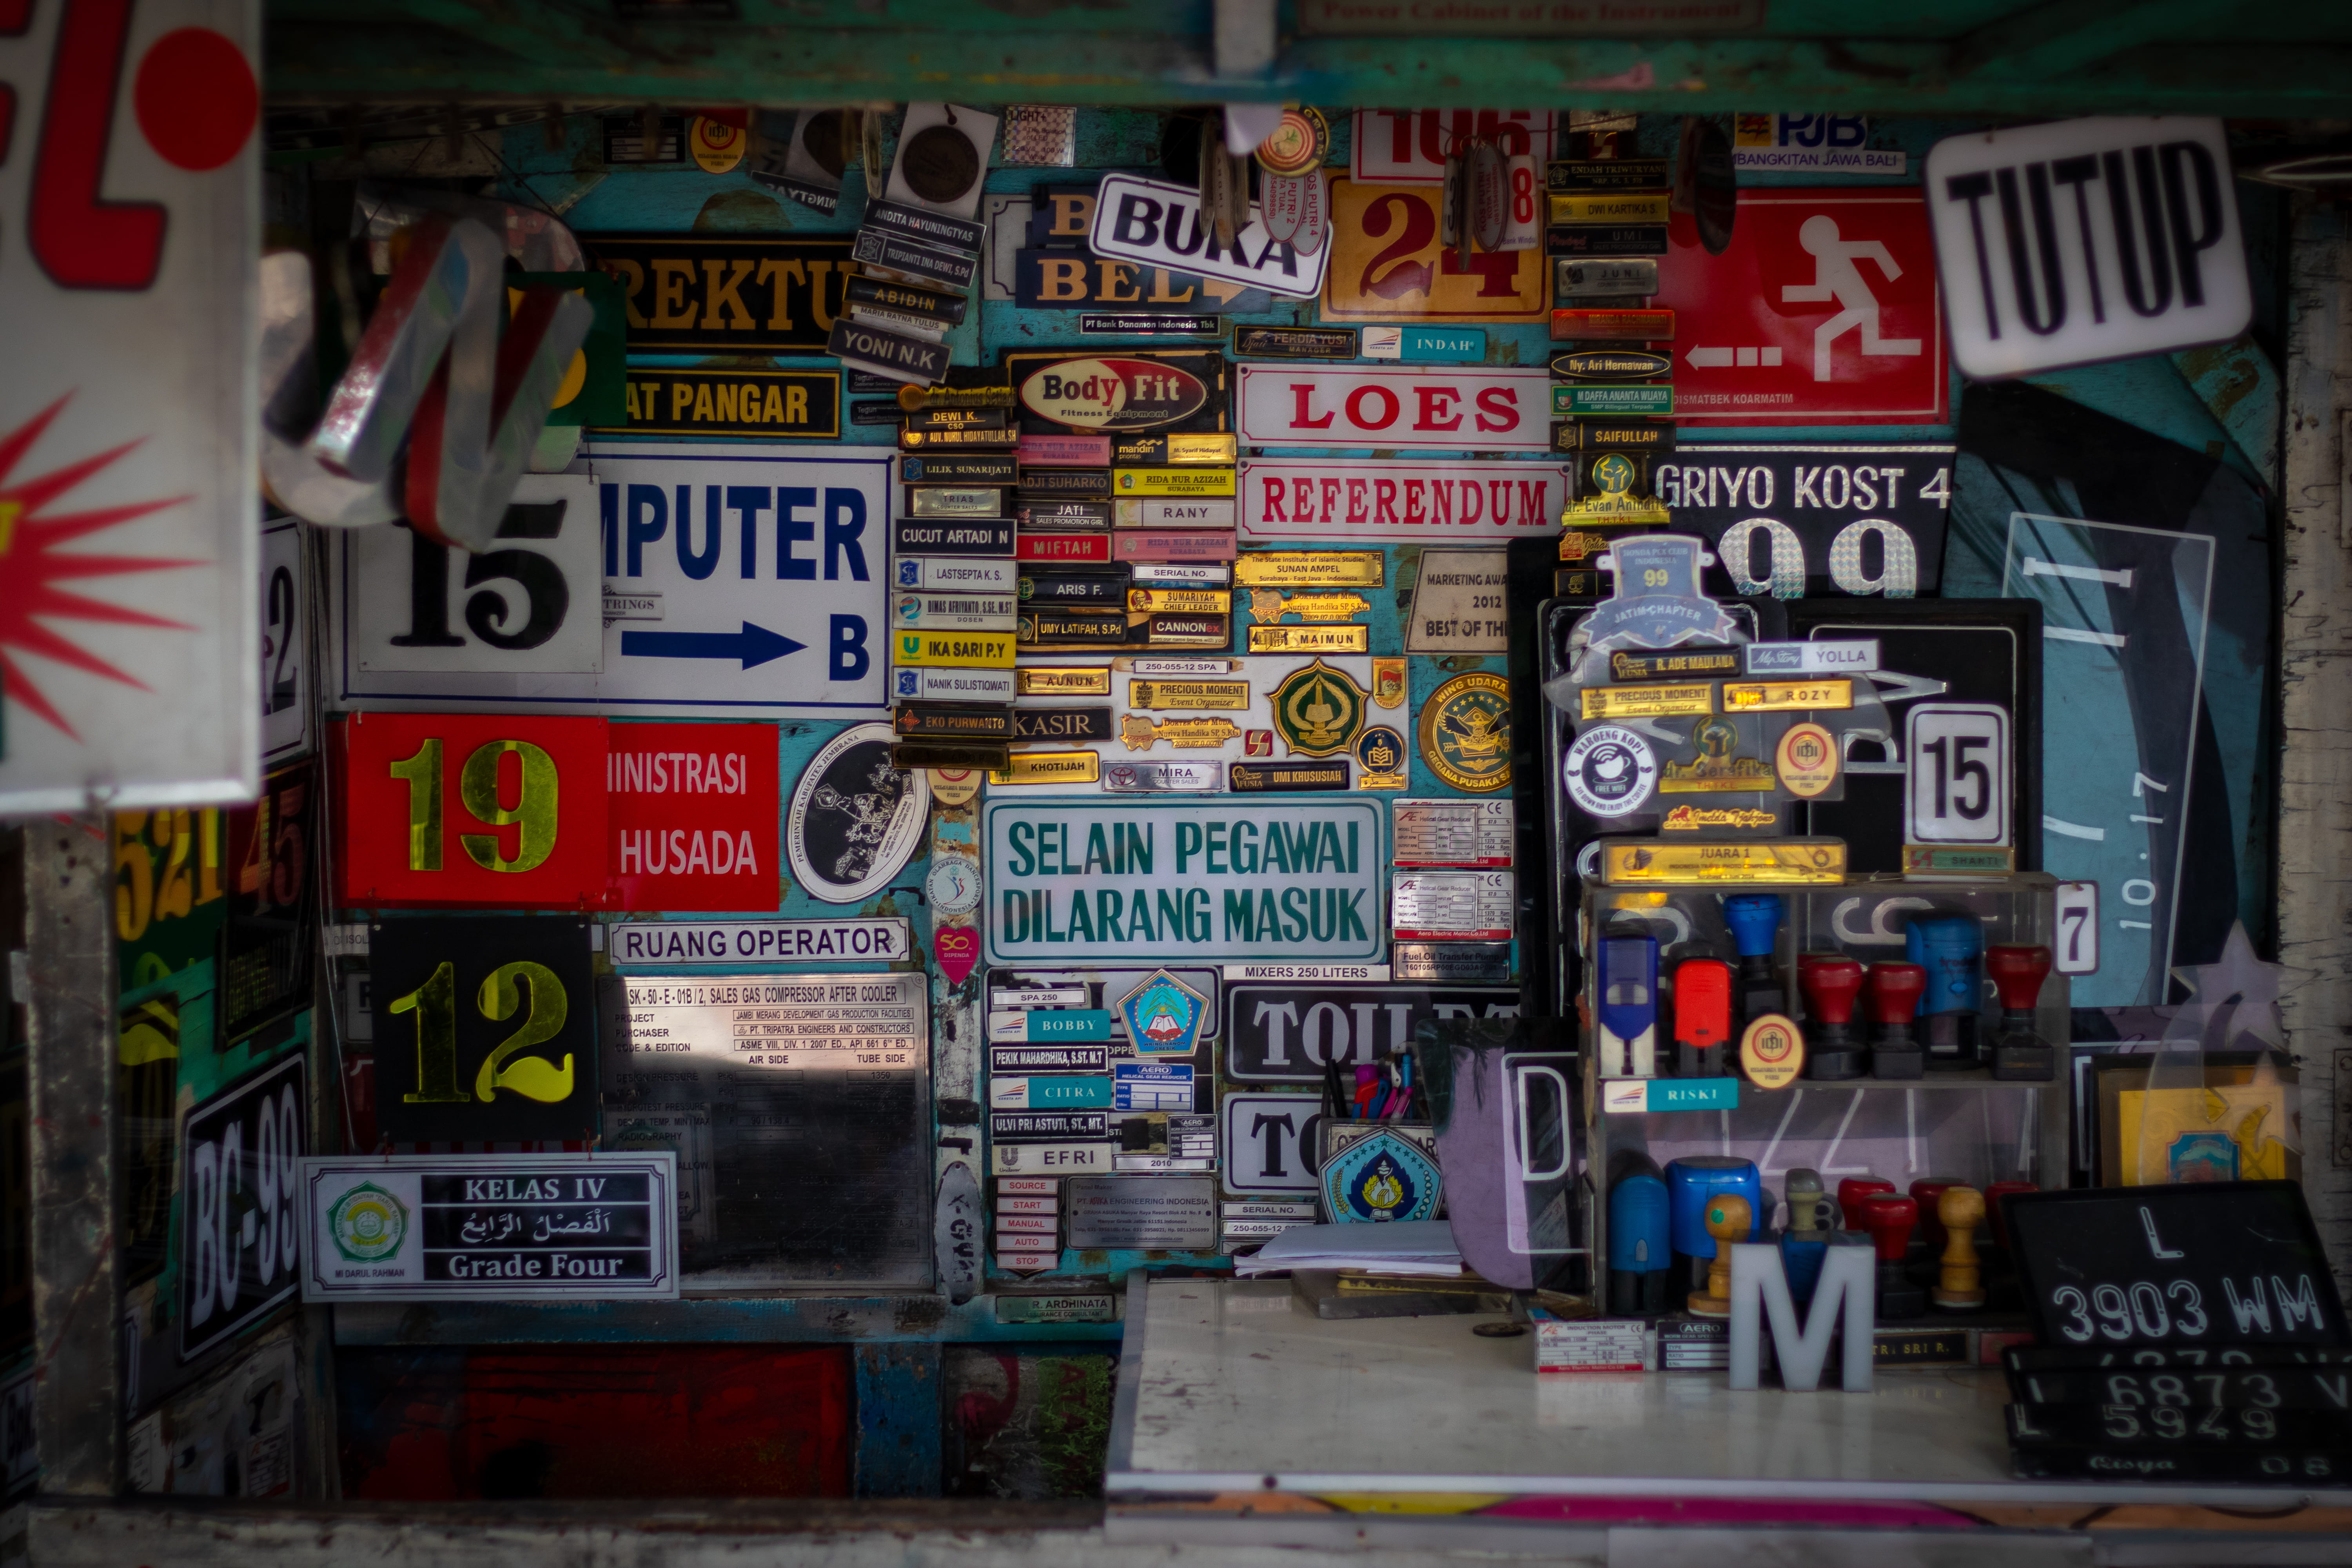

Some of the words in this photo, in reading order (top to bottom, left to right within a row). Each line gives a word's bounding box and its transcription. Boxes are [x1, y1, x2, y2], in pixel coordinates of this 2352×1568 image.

[1513, 167, 1534, 223] 8
[875, 208, 907, 225] ANDITA
[908, 216, 974, 242] HAYUNINGTYAS
[1944, 140, 2226, 341] TUTUP
[875, 289, 935, 311] ABIDIN
[1086, 320, 1094, 329] PT
[1096, 320, 1116, 329] Bank
[1118, 320, 1156, 329] Danamon
[1158, 320, 1198, 330] Indonesia,
[1201, 320, 1215, 329] Tbk
[844, 330, 894, 359] YONI
[899, 344, 936, 370] N.K
[1416, 338, 1470, 351] INDAH
[1570, 360, 1585, 372] Ny.
[1588, 359, 1602, 370] Ari
[1605, 359, 1653, 370] Hernawan
[1042, 374, 1120, 411] Body
[1134, 375, 1180, 401] Fit
[672, 383, 808, 424] PANGAR
[1289, 383, 1521, 433] LOES
[933, 412, 961, 422] DEWI
[967, 412, 978, 421] K.
[1061, 409, 1102, 418] Fitness
[1105, 409, 1169, 419] Equipment
[1595, 431, 1658, 442] SAIFULLAH
[1119, 446, 1154, 454] mandiri
[1655, 465, 1774, 510] GRIYO
[1795, 465, 1907, 511] KOST
[1918, 468, 1951, 509] 4
[1261, 477, 1548, 526] REFERENDUM
[1057, 505, 1083, 516] JATI
[1164, 508, 1209, 518] RANY
[902, 529, 943, 543] CUCUT
[947, 530, 992, 544] ARTADI
[999, 530, 1008, 544] N
[1033, 541, 1092, 555] MIFTAH
[389, 497, 570, 651] 15
[1644, 569, 1668, 587] 99
[1056, 585, 1086, 595] ARIS
[1093, 586, 1103, 595] F.
[1167, 593, 1215, 601] SUMARIYAH
[1473, 596, 1502, 609] 2012
[1300, 635, 1353, 644] MAIMUN
[829, 613, 870, 682] B
[1817, 650, 1867, 663] YOLLA
[1047, 677, 1093, 686] AUNUN
[1160, 685, 1203, 695] PRECIOUS
[1206, 685, 1245, 695] MOMENT
[1435, 681, 1464, 703] WING
[1467, 678, 1506, 692] UDARA
[1615, 691, 1663, 701] PRECIOUS
[1664, 689, 1706, 700] MOMENT
[1786, 690, 1831, 701] ROZY
[1196, 697, 1235, 708] Organizer
[926, 716, 945, 728] EKO
[948, 717, 1005, 730] PURWANTO
[1574, 730, 1619, 756] WAROENG
[1622, 730, 1645, 754] KOPI
[608, 751, 747, 795] INISTRASI
[1031, 762, 1085, 772] KHOTIJAH
[1159, 769, 1193, 777] MIRA
[1922, 735, 1991, 822] 15
[389, 737, 560, 874] 19
[619, 828, 759, 877] HUSADA
[1008, 821, 1154, 877] SELAIN
[1176, 819, 1360, 874] PEGAWAI
[1700, 849, 1740, 858] JUARA
[1744, 849, 1749, 858] 1
[1951, 856, 2000, 866] SHANTI
[1003, 888, 1210, 946] DILARANG
[1223, 886, 1368, 942] MASUK
[2062, 906, 2087, 963] 7
[627, 931, 727, 958] RUANG
[736, 927, 892, 956] OPERATOR
[1245, 967, 1294, 978] MIXERS
[1298, 968, 1319, 978] 250
[1323, 968, 1368, 978] LITERS
[710, 989, 738, 1004] SALES
[742, 988, 761, 1003] GAS
[765, 987, 826, 1003] COMPRESSOR
[829, 986, 857, 1002] AFTER
[861, 986, 898, 1002] COOLER
[389, 960, 575, 1103] 12
[1042, 1020, 1096, 1031] BOBBY
[749, 1055, 765, 1064] AIR
[769, 1055, 789, 1063] SIDE
[857, 1054, 882, 1063] TUBE
[886, 1054, 905, 1063] SIDE
[1045, 1087, 1096, 1098] CITRA
[1667, 1089, 1718, 1100] RISKI
[1044, 1151, 1094, 1165] EFRI
[465, 1179, 559, 1200] KELAS
[575, 1178, 607, 1199] IV
[2140, 1206, 2185, 1259] L
[335, 1269, 344, 1278] MI
[345, 1269, 371, 1278] DARUL
[372, 1268, 405, 1277] RAHMAN
[448, 1254, 542, 1278] Grade
[550, 1254, 623, 1276] Four
[2053, 1279, 2208, 1342] 3903
[2223, 1274, 2325, 1334] WM
[1728, 1243, 1876, 1393] M
[1904, 1343, 1931, 1355] SRI
[1936, 1342, 1951, 1353] R.
